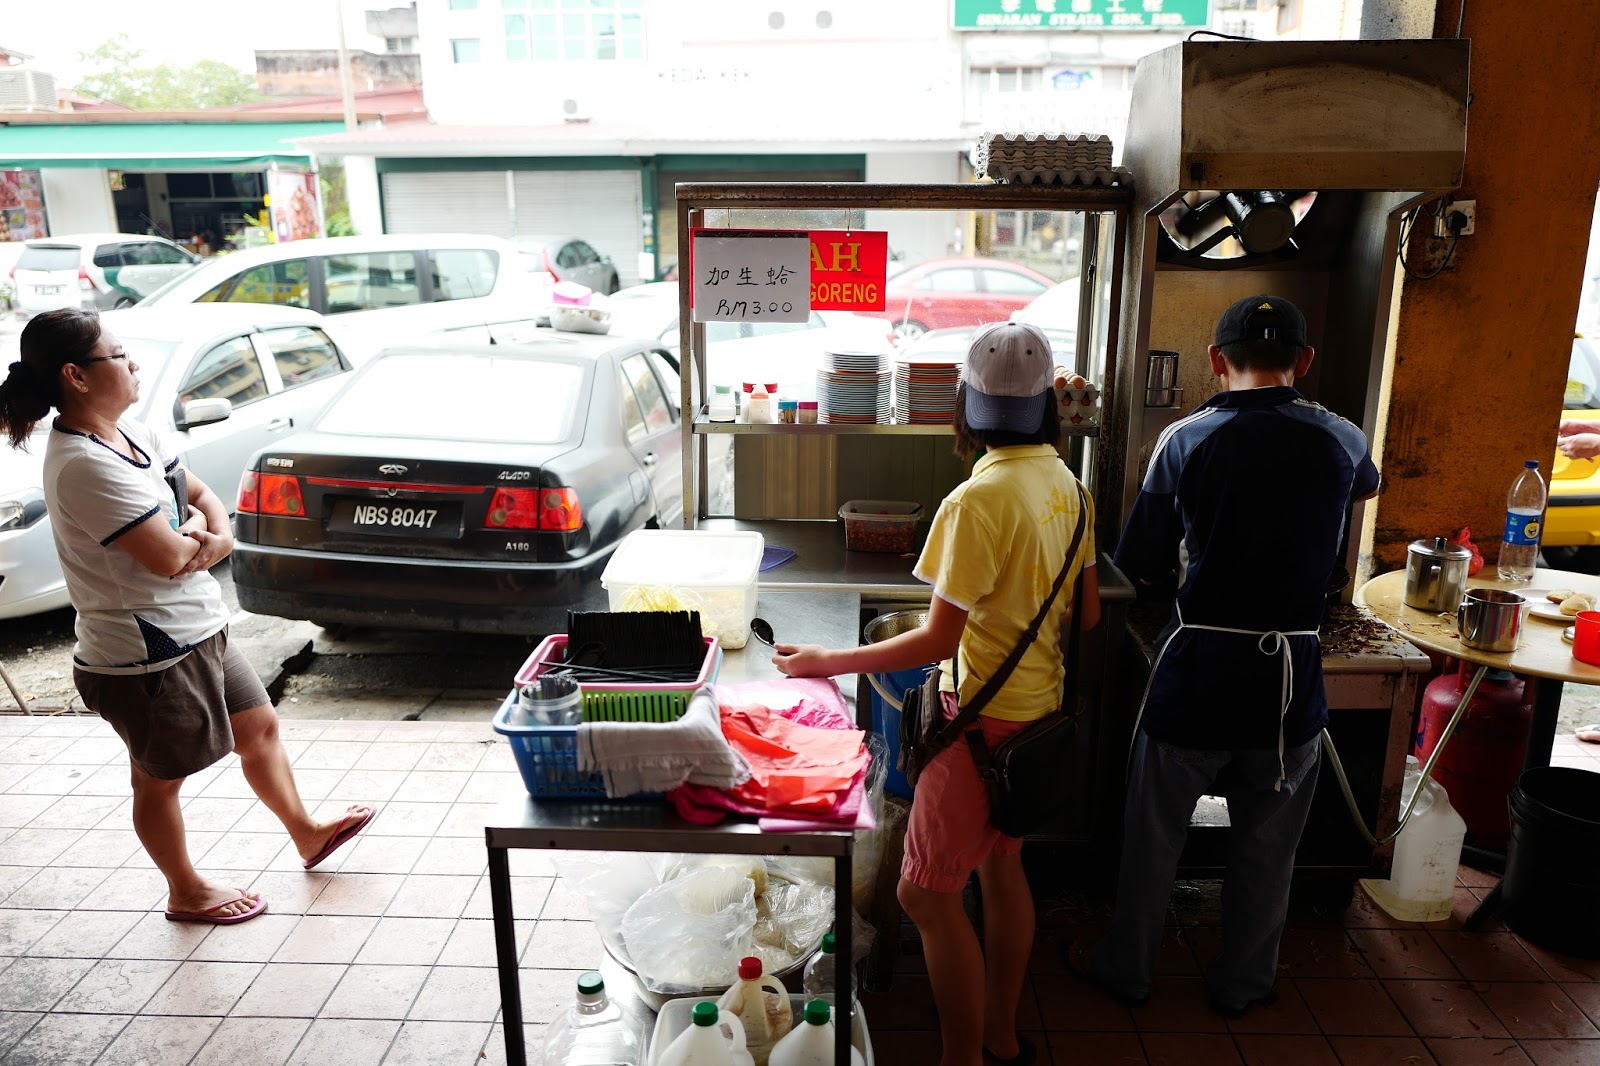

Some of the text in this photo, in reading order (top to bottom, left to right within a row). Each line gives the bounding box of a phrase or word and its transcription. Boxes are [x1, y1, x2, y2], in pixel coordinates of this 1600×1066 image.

[1049, 14, 1104, 26] STRATA
[353, 505, 438, 528] NBS 8047
[505, 541, 530, 551] A160
